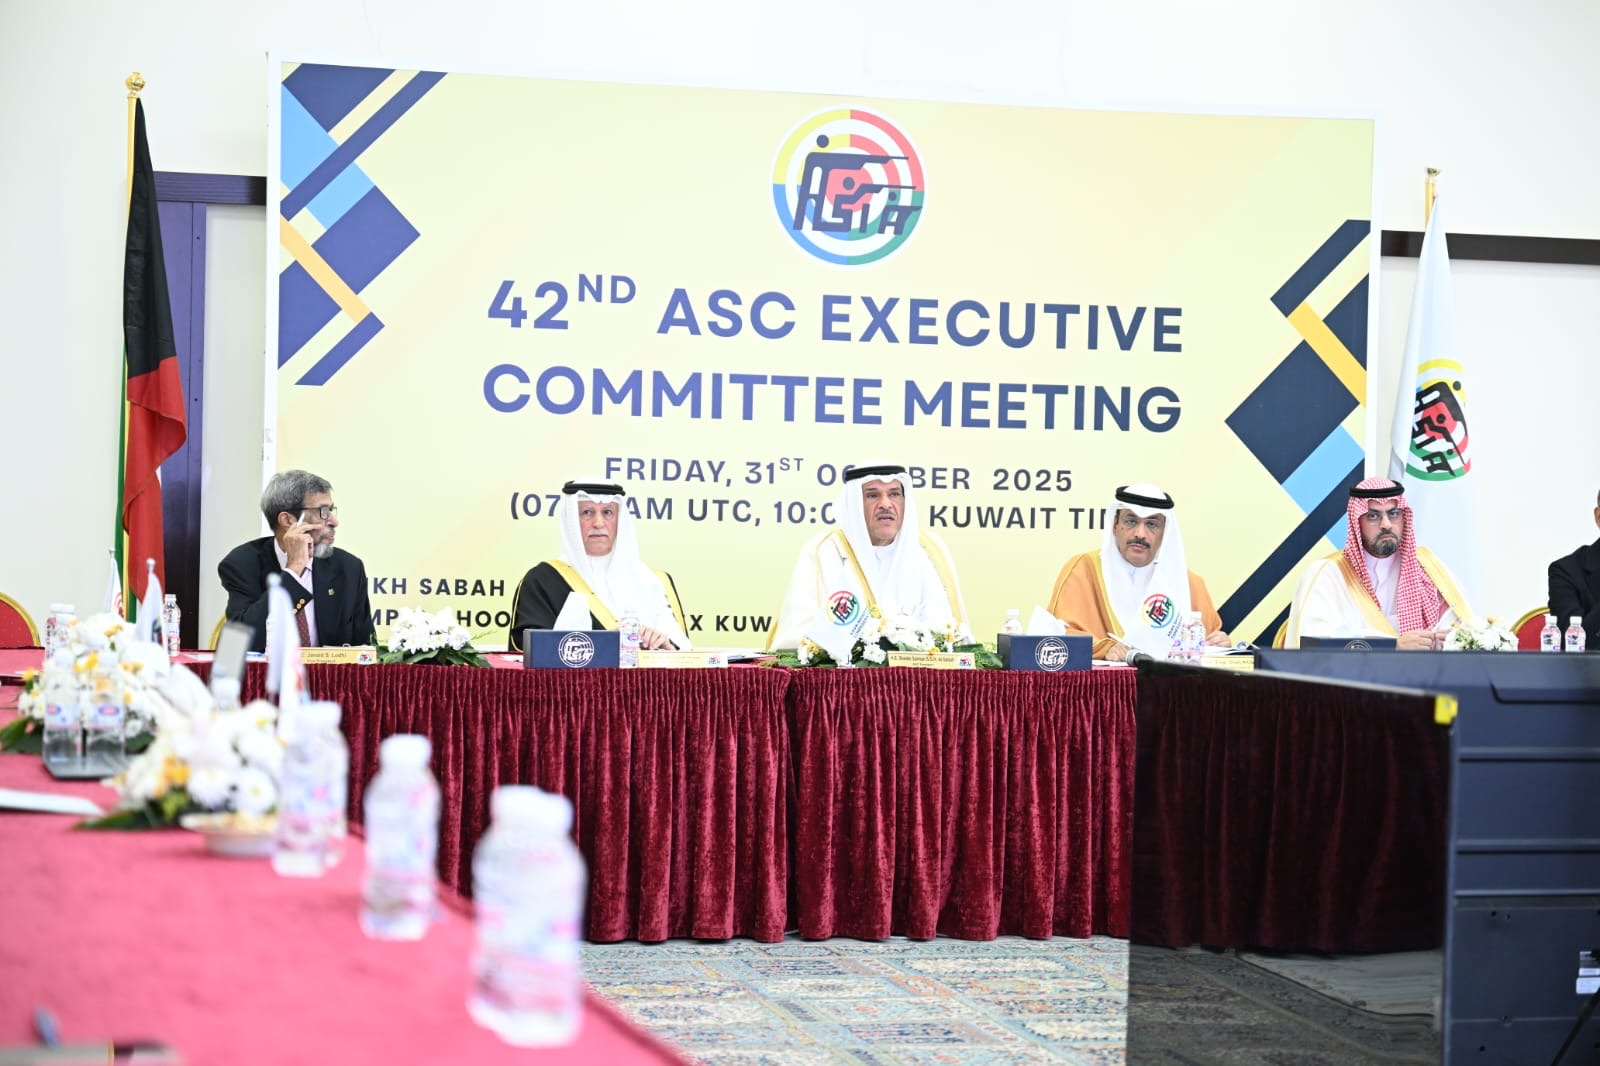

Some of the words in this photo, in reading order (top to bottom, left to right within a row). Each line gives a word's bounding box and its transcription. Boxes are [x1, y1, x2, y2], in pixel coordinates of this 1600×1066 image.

[656, 288, 797, 340] ASC
[821, 294, 1183, 353] EXECUTIVE
[483, 363, 883, 426] COMMITTEE
[903, 380, 1182, 433] MEETING
[605, 457, 733, 487] FRIDAY,
[992, 467, 1073, 492] 2025
[626, 496, 673, 520] AM
[688, 498, 761, 526] UTC,
[773, 501, 837, 525] 10:0
[928, 505, 1057, 530] KUWAIT
[419, 578, 505, 597] SABAH
[715, 615, 772, 632] KUW
